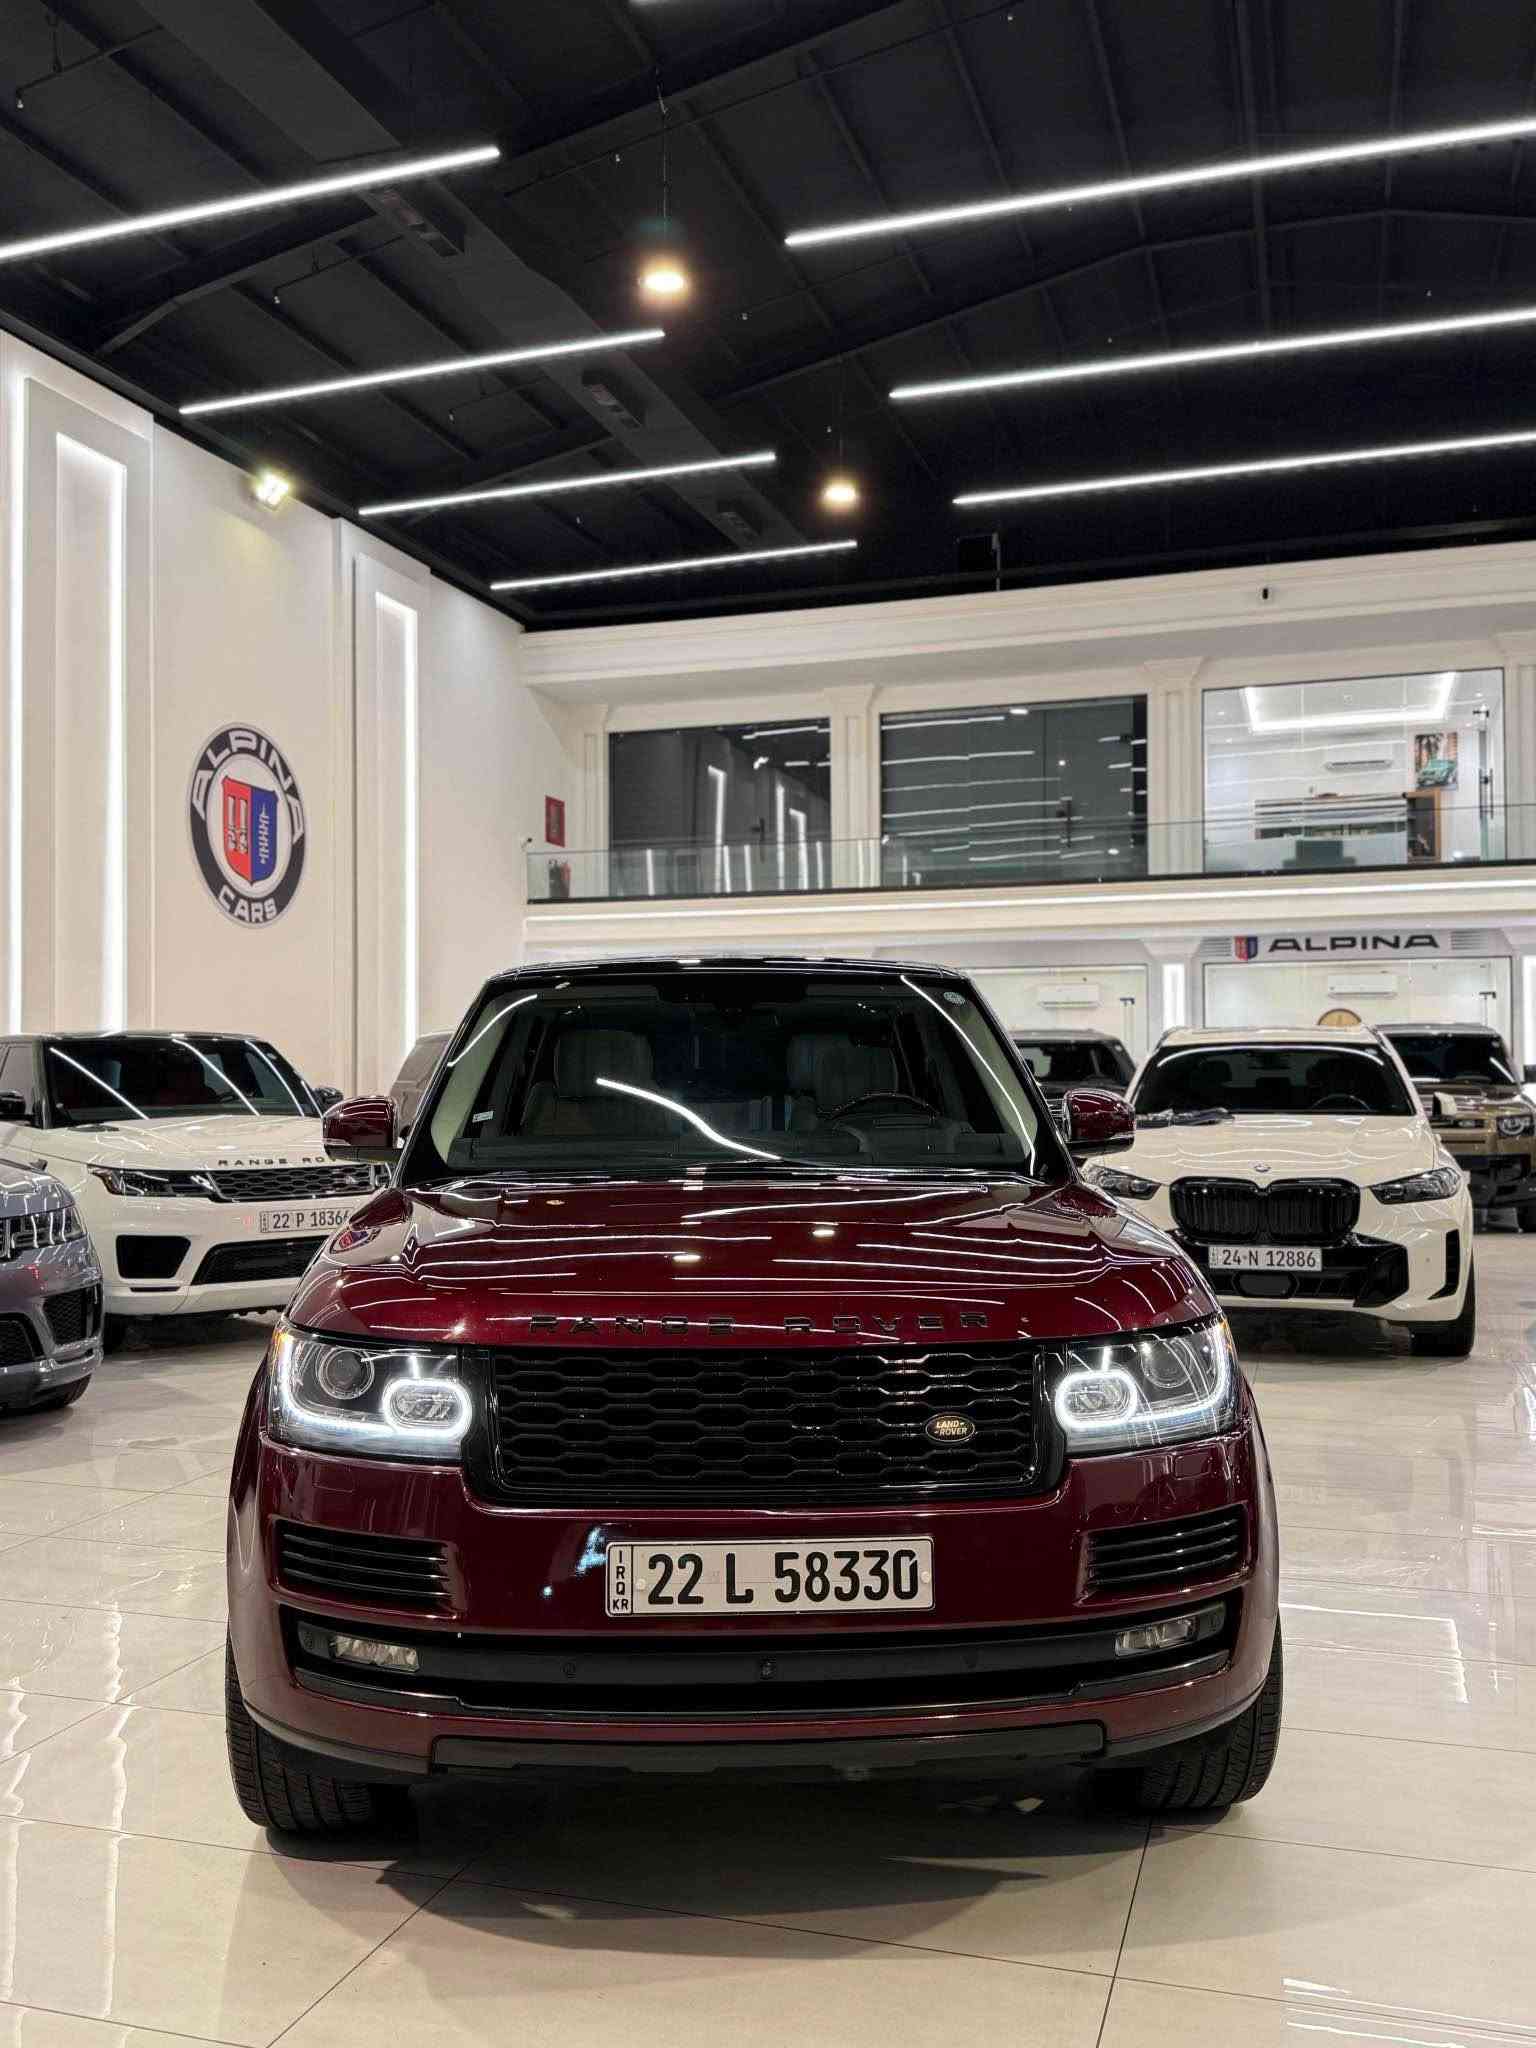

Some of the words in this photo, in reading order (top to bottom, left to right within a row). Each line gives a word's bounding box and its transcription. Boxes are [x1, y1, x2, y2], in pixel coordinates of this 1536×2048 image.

[191, 731, 305, 844] ALPINA
[218, 888, 278, 924] CARS
[1268, 934, 1439, 952] ALPINA
[218, 1158, 288, 1166] RANGE
[273, 1213, 290, 1229] 22
[296, 1212, 304, 1227] P
[1222, 1249, 1241, 1266] 24
[1248, 1250, 1259, 1266] N
[1266, 1250, 1316, 1268] 12886
[528, 1315, 736, 1336] RANGE
[783, 1312, 990, 1334] ROVER
[936, 1420, 960, 1428] LAND
[939, 1427, 968, 1436] ROVER
[647, 1553, 705, 1606] 22
[725, 1552, 755, 1604] L
[774, 1549, 919, 1603] 58330
[612, 1598, 630, 1612] KR
